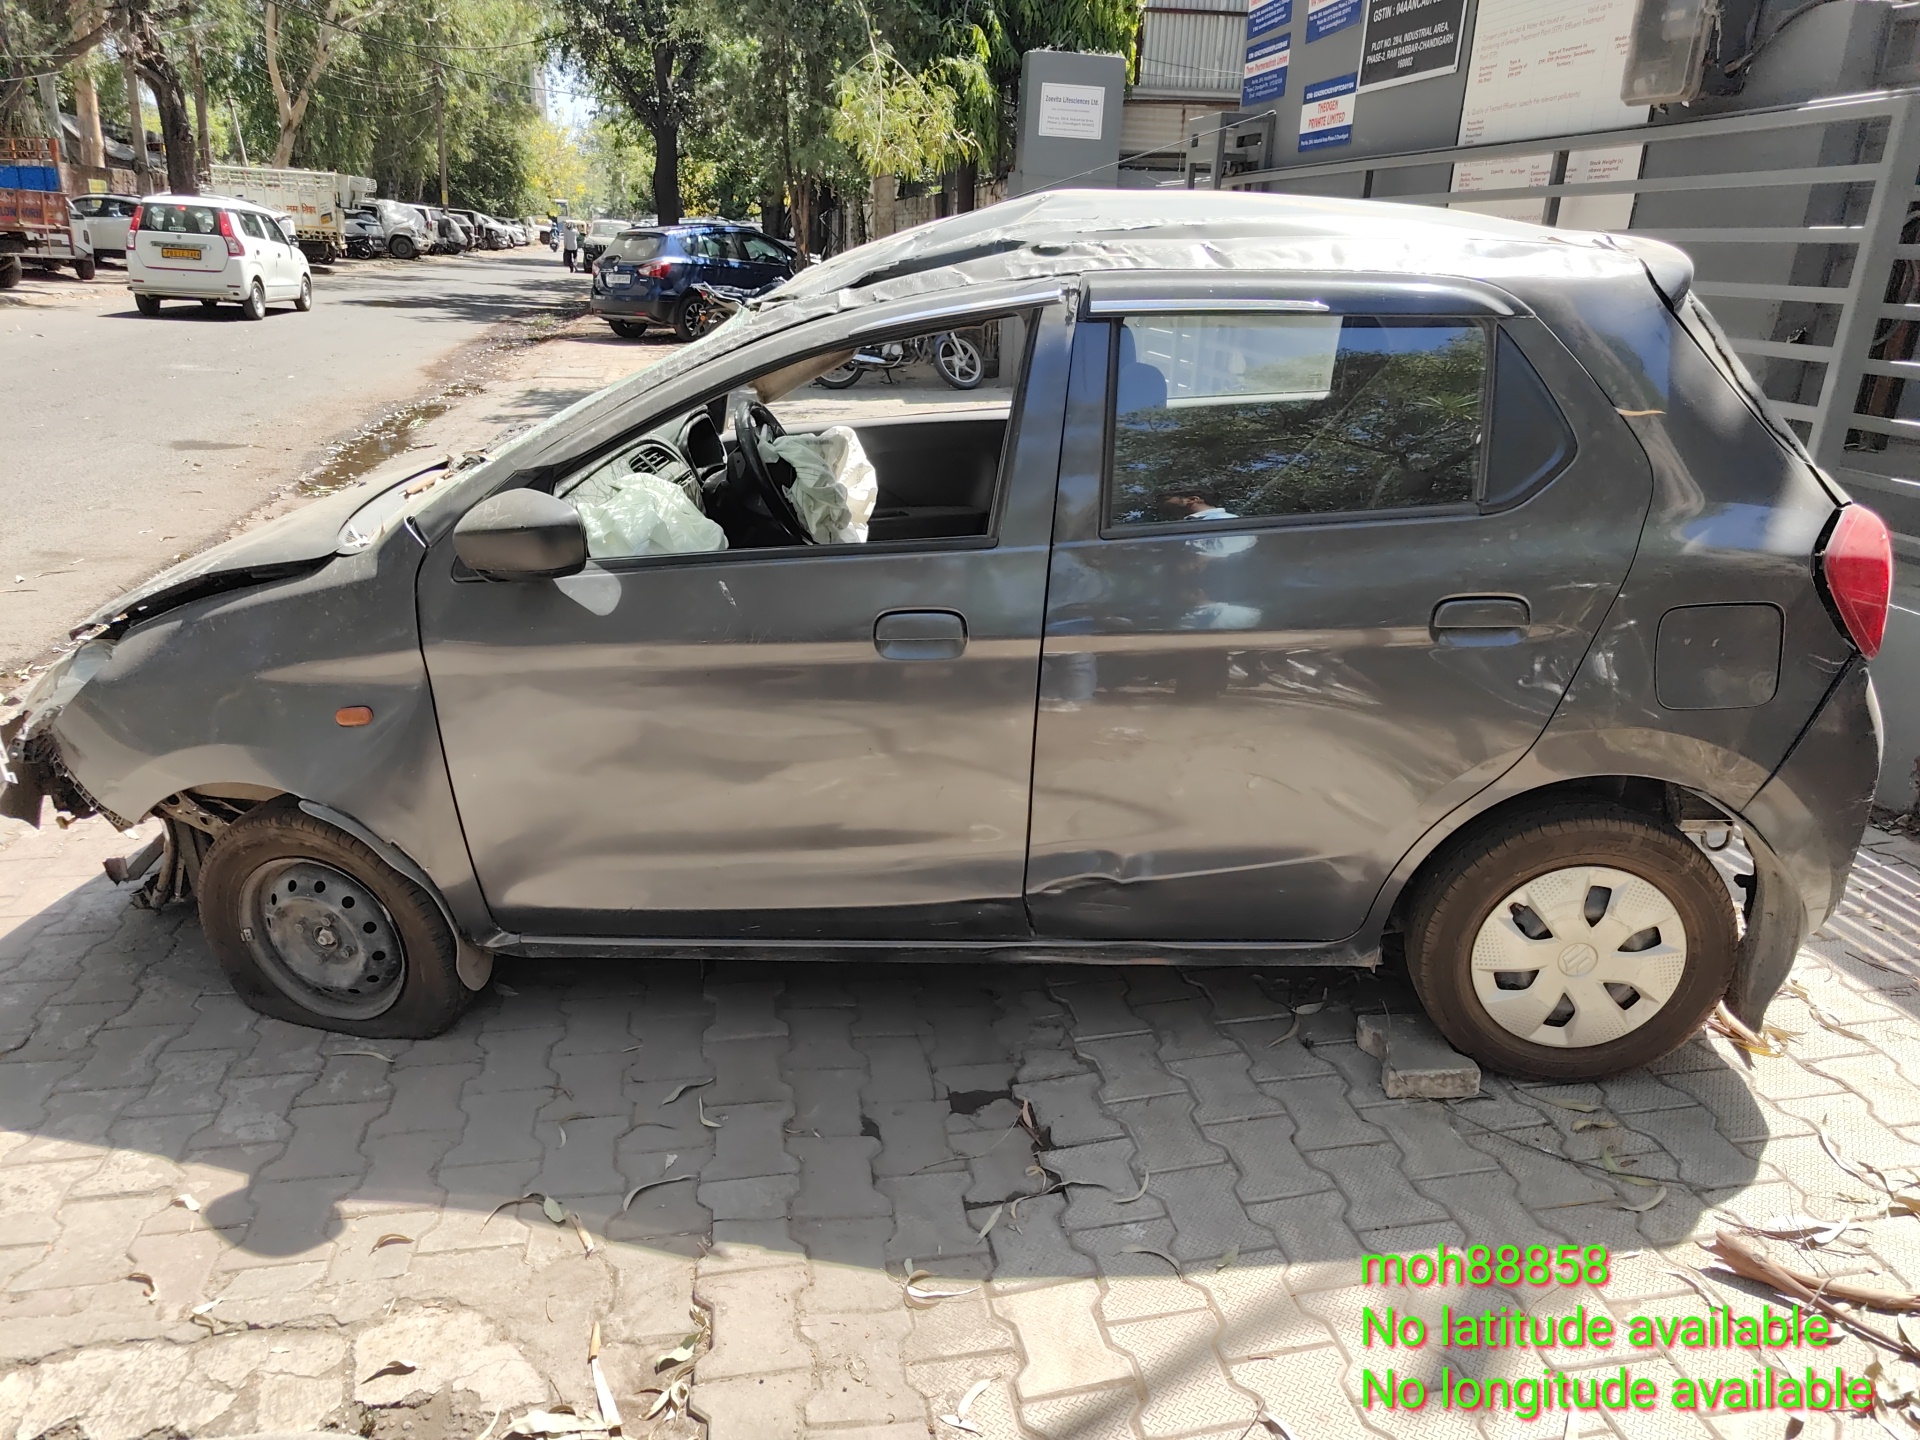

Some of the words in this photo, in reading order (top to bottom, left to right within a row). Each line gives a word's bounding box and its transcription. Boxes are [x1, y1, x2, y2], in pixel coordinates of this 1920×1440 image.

[1373, 5, 1392, 22] GSTIN
[1371, 40, 1384, 51] PLOT
[1404, 26, 1432, 42] INDUSTRIAL
[1387, 48, 1397, 60] RAM
[1045, 95, 1062, 103] Zoevita
[1062, 96, 1090, 105] Lifesciences
[1090, 98, 1100, 106] Ltd.
[1317, 99, 1339, 114] THEOGEN
[1308, 115, 1327, 129] PRIVATE
[1327, 112, 1346, 126] LIMITED
